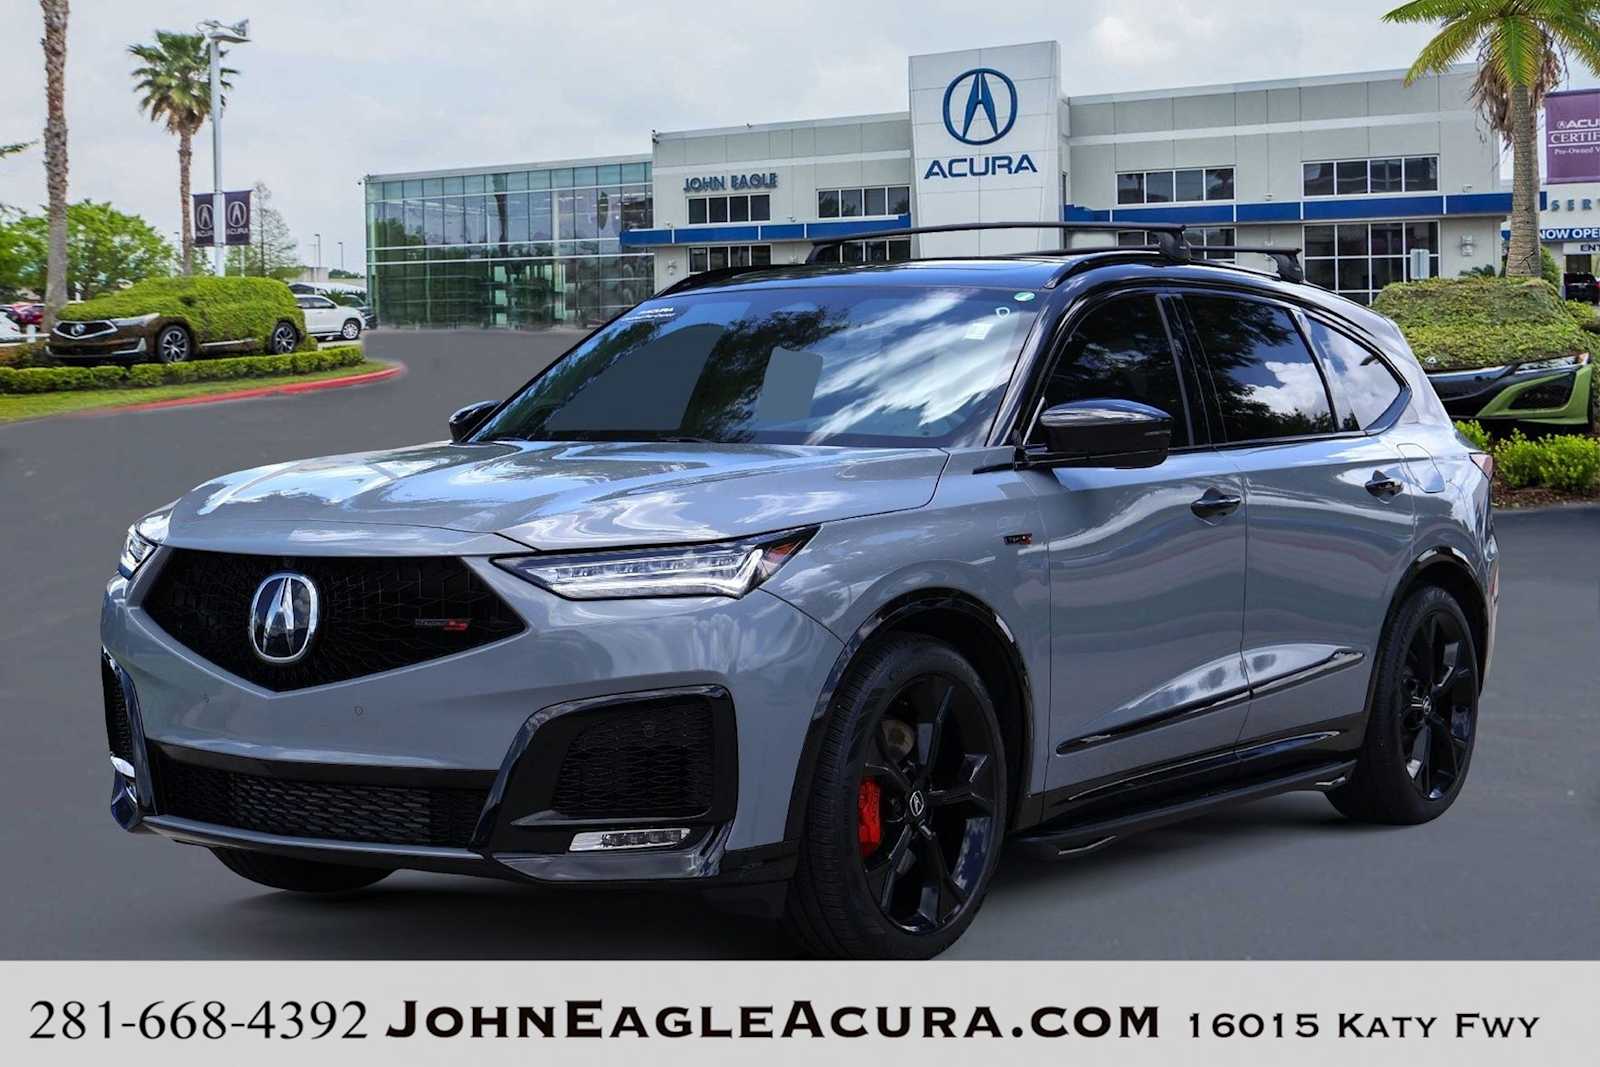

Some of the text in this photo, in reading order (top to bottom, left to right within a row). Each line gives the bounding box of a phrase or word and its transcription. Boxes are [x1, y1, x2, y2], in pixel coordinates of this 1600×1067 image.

[1566, 118, 1600, 128] ACU
[924, 153, 1038, 180] ACURA
[683, 172, 777, 192] JOHN EAGLE
[1551, 198, 1600, 211] SER
[1539, 228, 1600, 239] NOW OPE
